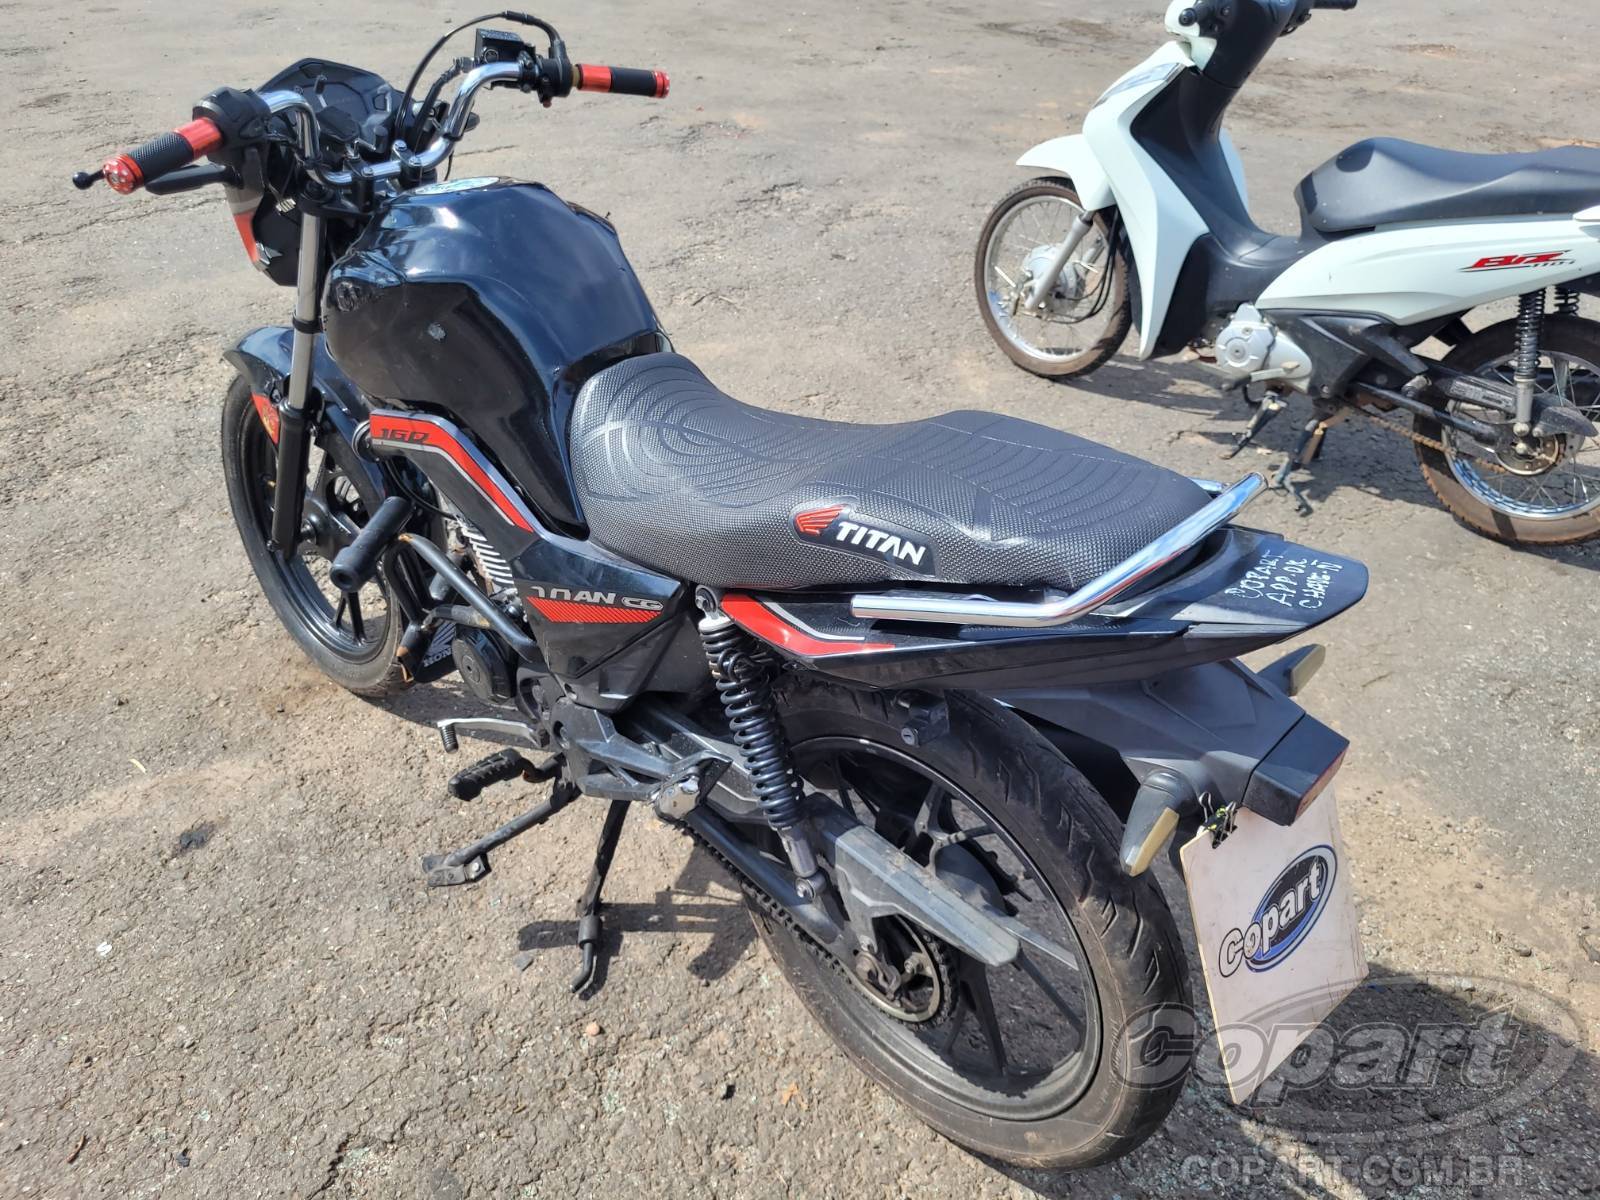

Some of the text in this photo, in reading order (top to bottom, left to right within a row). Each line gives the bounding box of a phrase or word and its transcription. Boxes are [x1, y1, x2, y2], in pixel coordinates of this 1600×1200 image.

[381, 428, 430, 444] 160
[836, 521, 926, 566] TITAN
[1218, 855, 1322, 978] Copart
